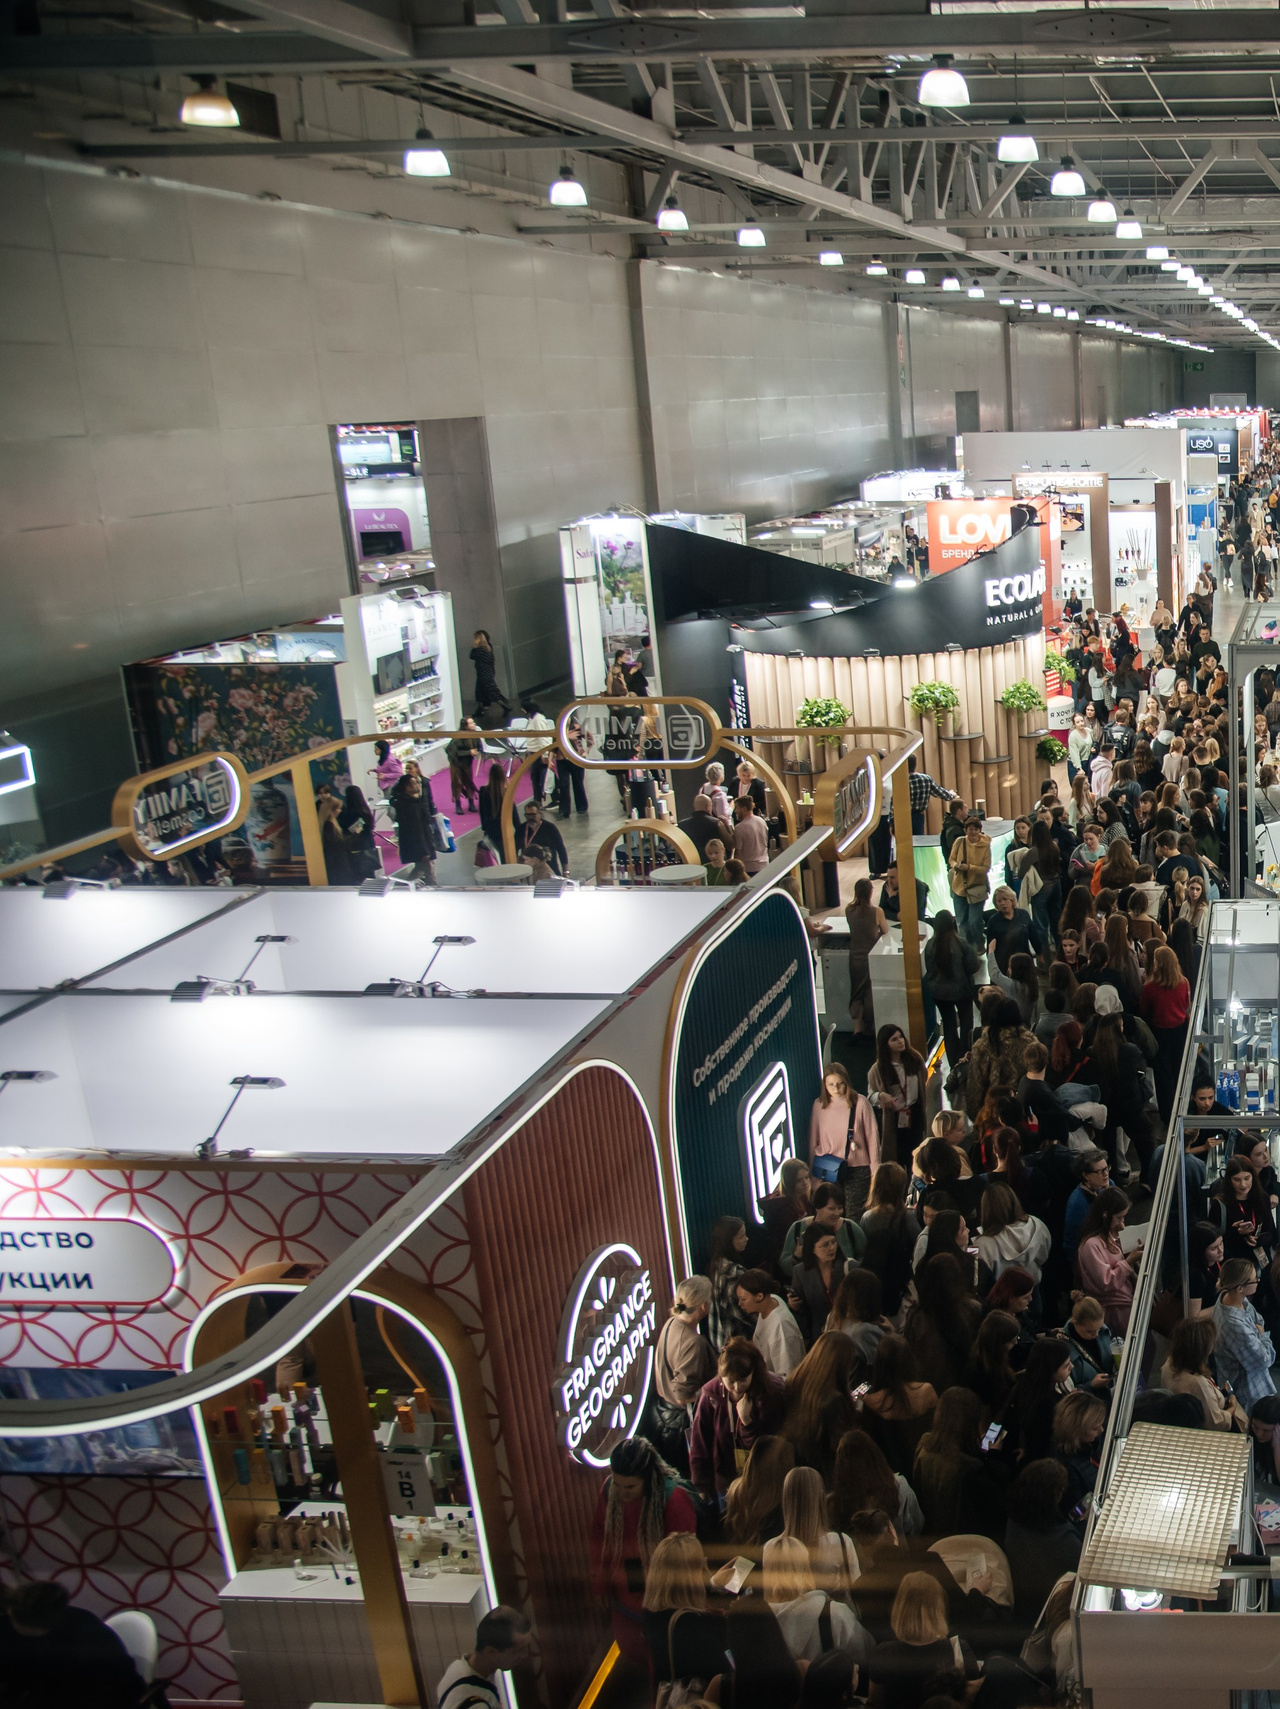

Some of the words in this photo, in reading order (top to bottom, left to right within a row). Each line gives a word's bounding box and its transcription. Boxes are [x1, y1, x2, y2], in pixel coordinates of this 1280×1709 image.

[939, 515, 1012, 545] LOV
[986, 610, 1028, 626] NATURAL
[693, 1016, 749, 1088] Собственное
[749, 959, 799, 1025] производство
[708, 1089, 717, 1106] и
[716, 1046, 755, 1098] продажа
[754, 995, 792, 1050] косметики
[562, 1269, 653, 1413] FRAGRANCE
[566, 1301, 656, 1449] GEOGRAPHY
[397, 1470, 412, 1480] 14
[398, 1481, 416, 1498] B
[406, 1500, 414, 1511] 1
